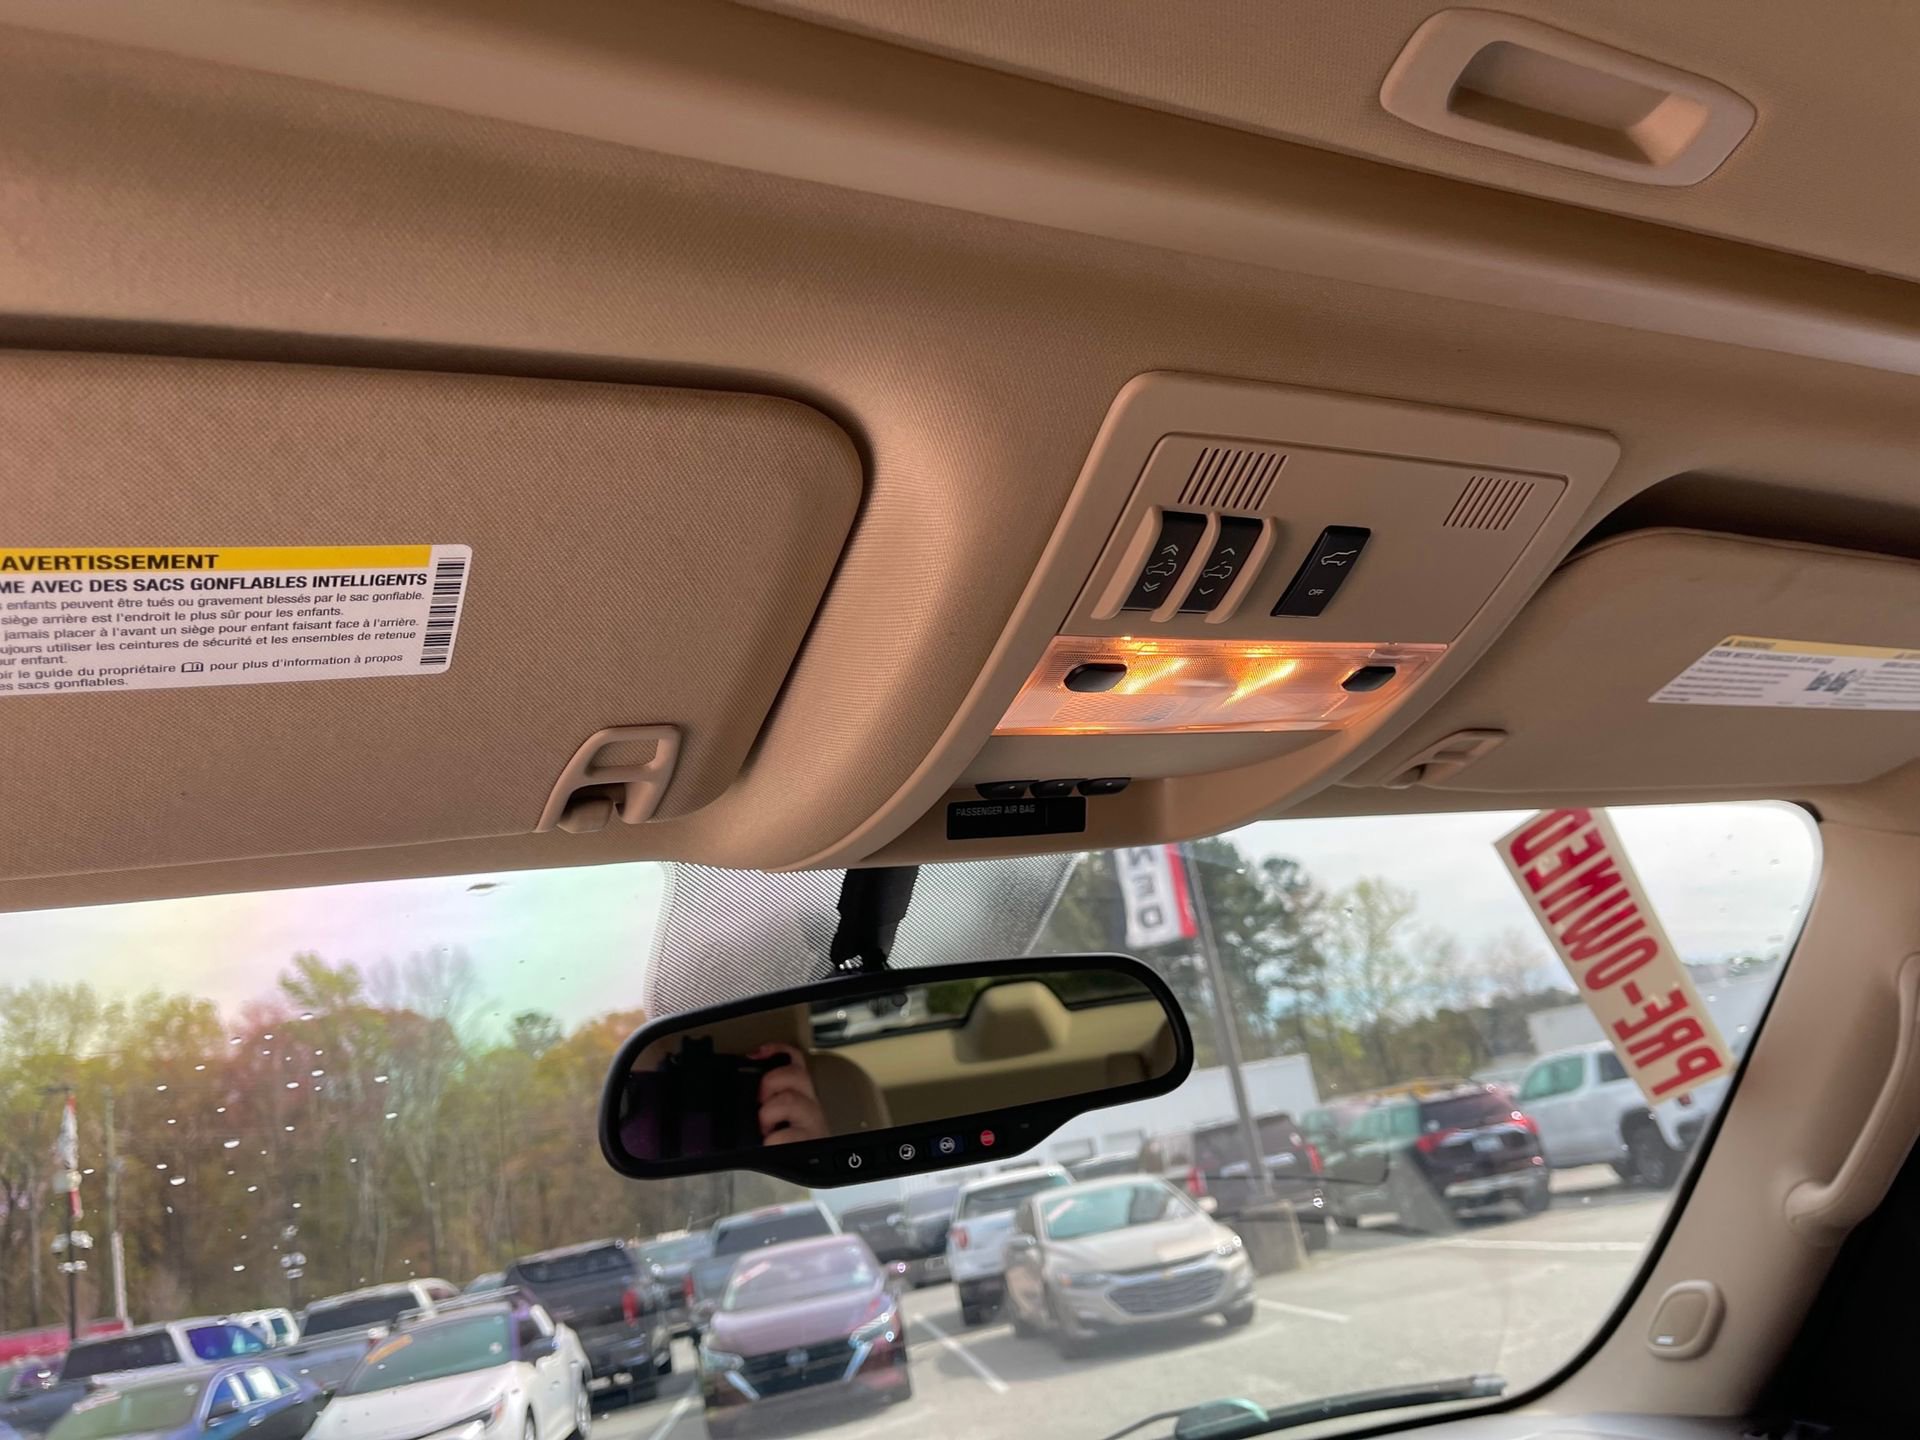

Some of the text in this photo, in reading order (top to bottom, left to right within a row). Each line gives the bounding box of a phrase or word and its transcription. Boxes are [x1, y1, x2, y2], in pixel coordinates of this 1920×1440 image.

[2, 554, 219, 571] AVERTISSEMENT
[32, 579, 82, 593] AVEC
[89, 579, 127, 592] DES
[133, 578, 184, 591] SACS
[191, 576, 307, 591] GONFLABLES
[312, 573, 427, 587] INTELLIGENTS
[1308, 588, 1325, 596] OFF
[7, 590, 424, 611] enfants peuvent être tués ou gravement blessés par le sac gonflable.
[2, 606, 343, 626] siège arrière est l'endroit le plus sûr pour les enfants.
[4, 617, 419, 641] jamais placer à l'avant un siège pour enfant faisant face à l'arrière.
[47, 642, 92, 653] utiliser
[97, 641, 115, 651] les
[119, 640, 179, 650] ceintures
[183, 638, 199, 648] de
[203, 636, 252, 648] sécurité
[256, 636, 267, 645] et
[271, 635, 288, 644] les
[292, 632, 354, 643] ensembles
[357, 632, 371, 641] de
[374, 631, 416, 640] retenue
[18, 670, 31, 679] le
[35, 668, 73, 680] guide
[78, 667, 94, 677] du
[99, 663, 176, 677] propriétaire
[210, 661, 239, 671] pour
[242, 659, 268, 671] plus
[272, 656, 351, 667] d'information
[354, 655, 361, 664] à
[364, 654, 403, 664] propos
[21, 655, 67, 666] enfant.
[18, 681, 50, 690] sacs
[54, 677, 129, 690] gonflables.
[955, 804, 1035, 817] PASSENGER AIR BAG
